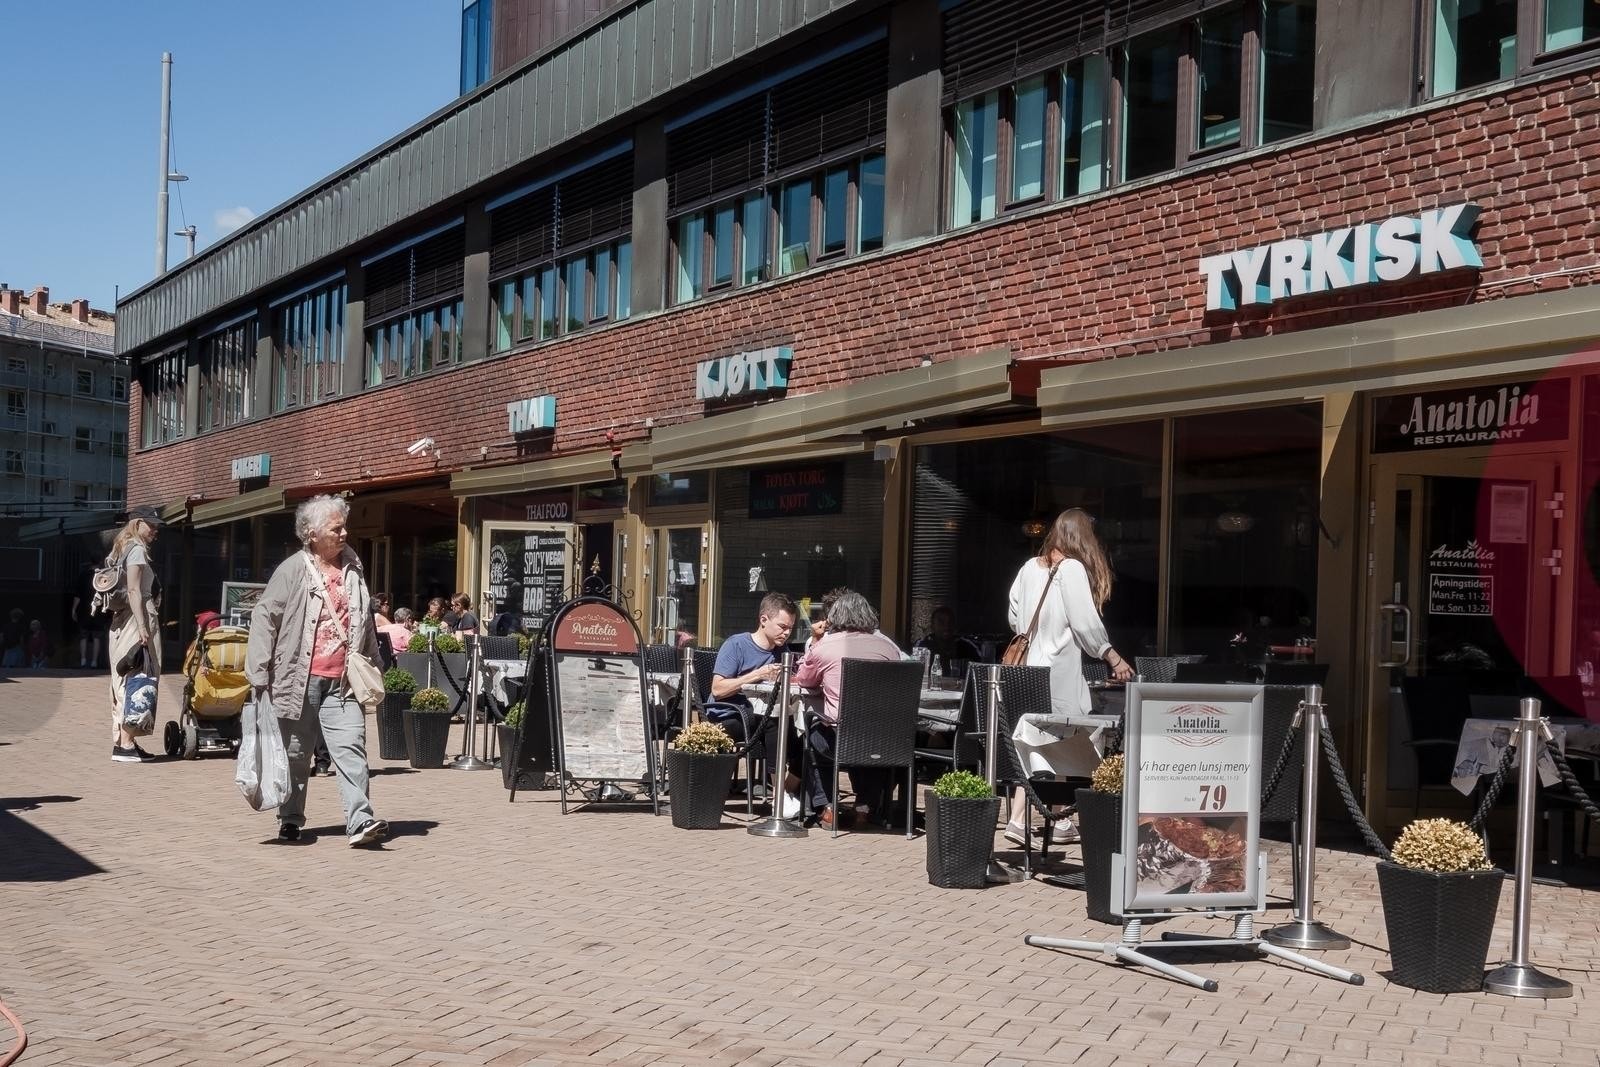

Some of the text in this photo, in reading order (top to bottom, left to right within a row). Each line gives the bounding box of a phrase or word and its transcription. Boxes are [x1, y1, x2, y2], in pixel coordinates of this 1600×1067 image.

[1199, 203, 1468, 311] TYRKISK
[696, 348, 781, 400] KJØTT
[507, 396, 545, 433] THAI
[1400, 386, 1540, 434] Anatolia
[1414, 429, 1525, 445] RESTAURANT
[800, 470, 826, 486] TORG
[779, 492, 809, 512] KJØTT
[526, 502, 568, 520] THAI FOOD
[525, 535, 539, 550] WIFI
[1430, 544, 1496, 560] Anatolia
[524, 551, 545, 574] SPICY
[1430, 560, 1494, 569] RESTAURANT
[1468, 592, 1491, 601] 11-22
[1468, 604, 1490, 613] 13-22
[571, 622, 617, 636] Anatolia
[1173, 716, 1221, 729] Anatolia
[1151, 761, 1171, 772] har
[1172, 763, 1197, 775] egen
[1199, 761, 1223, 775] lunsj
[1224, 763, 1251, 775] meny
[1199, 784, 1227, 811] 79
